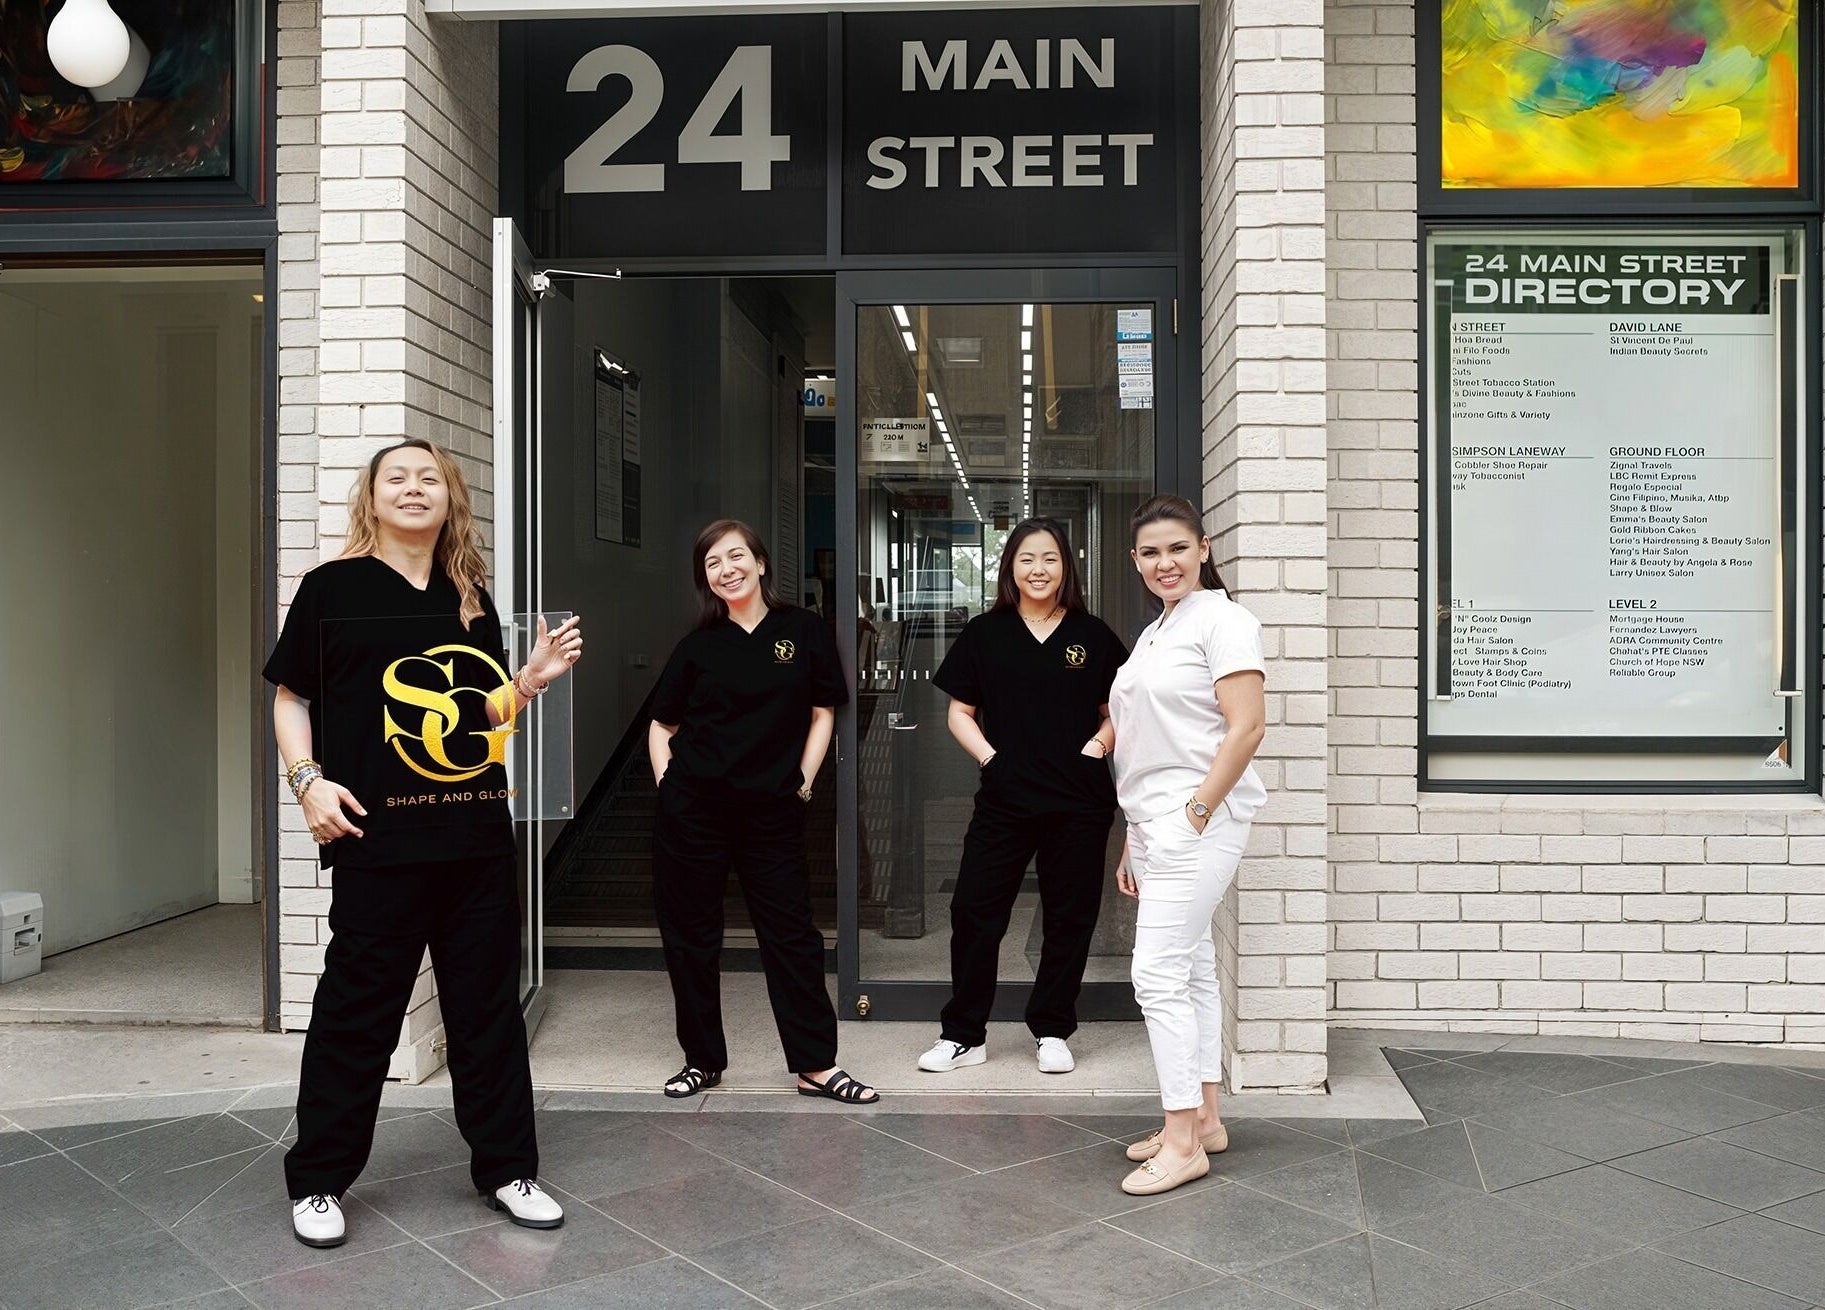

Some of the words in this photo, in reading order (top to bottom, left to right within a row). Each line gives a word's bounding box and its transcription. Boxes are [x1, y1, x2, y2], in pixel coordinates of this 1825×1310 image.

[901, 38, 1116, 92] MAIN
[563, 43, 791, 193] 24
[865, 133, 1154, 190] STREET
[1465, 255, 1508, 273] 24
[1520, 255, 1605, 273] MAIN
[1619, 256, 1746, 274] STREET
[1465, 279, 1746, 305] DIRECTORY
[1460, 323, 1506, 331] STREET
[1610, 323, 1646, 332] DAVID
[1650, 323, 1682, 332] LANE
[1610, 336, 1620, 344] St
[1622, 336, 1656, 344] Vincent
[1659, 336, 1670, 344] De
[1674, 336, 1693, 344] Paul
[1482, 346, 1510, 354] Foods
[1641, 348, 1671, 356] Beauty
[1493, 390, 1524, 398] Beauty
[1520, 411, 1550, 420] Variety
[1452, 447, 1506, 456] SIMPSON
[1509, 447, 1566, 456] LANEWAY
[1609, 447, 1661, 456] GROUND
[1665, 448, 1705, 456] FLOOR
[1518, 461, 1548, 470] Repair
[1610, 462, 1638, 470] Zignal
[1470, 472, 1525, 480] Tobacconist
[1661, 473, 1696, 481] Express
[1610, 483, 1641, 491] Regalo
[1644, 483, 1682, 492] Especial
[1633, 494, 1668, 503] Filipino,
[1708, 495, 1729, 503] Atbp
[1610, 505, 1638, 513] Shape
[1649, 516, 1680, 524] Beauty
[1668, 526, 1696, 534] Cakes
[1643, 537, 1699, 546] Hairdressing
[1712, 537, 1743, 546] Beauty
[1745, 537, 1771, 545] Salon
[1610, 548, 1639, 556] Yang's
[1640, 559, 1671, 567] Beauty
[1674, 559, 1684, 567] by
[1687, 559, 1718, 567] Angela
[1610, 569, 1633, 578] Larry
[1636, 569, 1666, 577] Unisex
[1668, 569, 1694, 577] Salon
[1468, 600, 1473, 608] 1
[1609, 600, 1646, 608] LEVEL
[1650, 600, 1657, 608] 2
[1500, 615, 1532, 624] Design
[1610, 616, 1653, 624] Mortgage
[1660, 626, 1697, 635] Lawyers
[1488, 636, 1514, 644] Salon
[1639, 637, 1690, 646] Community
[1475, 647, 1510, 656] Stamps
[1482, 658, 1500, 666] Hair
[1504, 658, 1527, 667] Shop
[1610, 658, 1642, 666] Church
[1645, 658, 1654, 666] of
[1656, 658, 1680, 667] Hope
[1452, 669, 1484, 677] Beauty
[1496, 669, 1518, 678] Body
[1648, 669, 1676, 678] Group
[1528, 680, 1571, 689] (Podiatry)
[1468, 690, 1497, 698] Dental
[386, 795, 437, 807] SHAPE
[442, 792, 472, 803] AND
[478, 789, 518, 800] GLOW
